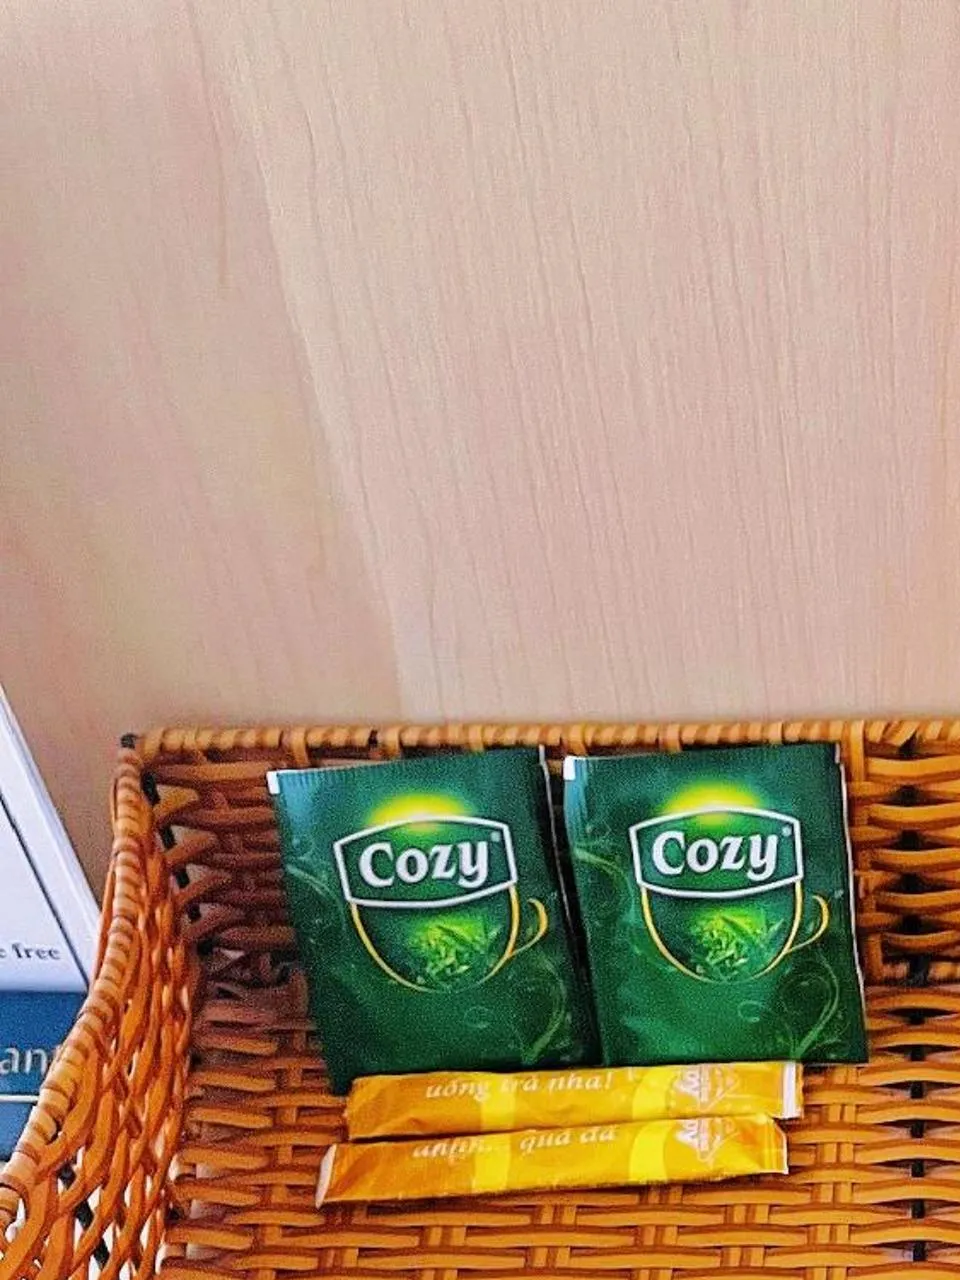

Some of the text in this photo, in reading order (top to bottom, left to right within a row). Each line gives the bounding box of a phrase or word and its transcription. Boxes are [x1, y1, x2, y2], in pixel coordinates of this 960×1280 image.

[358, 841, 489, 889] Cozy
[652, 830, 779, 882] Cozy
[11, 942, 61, 961] free
[0, 1046, 62, 1075] an
